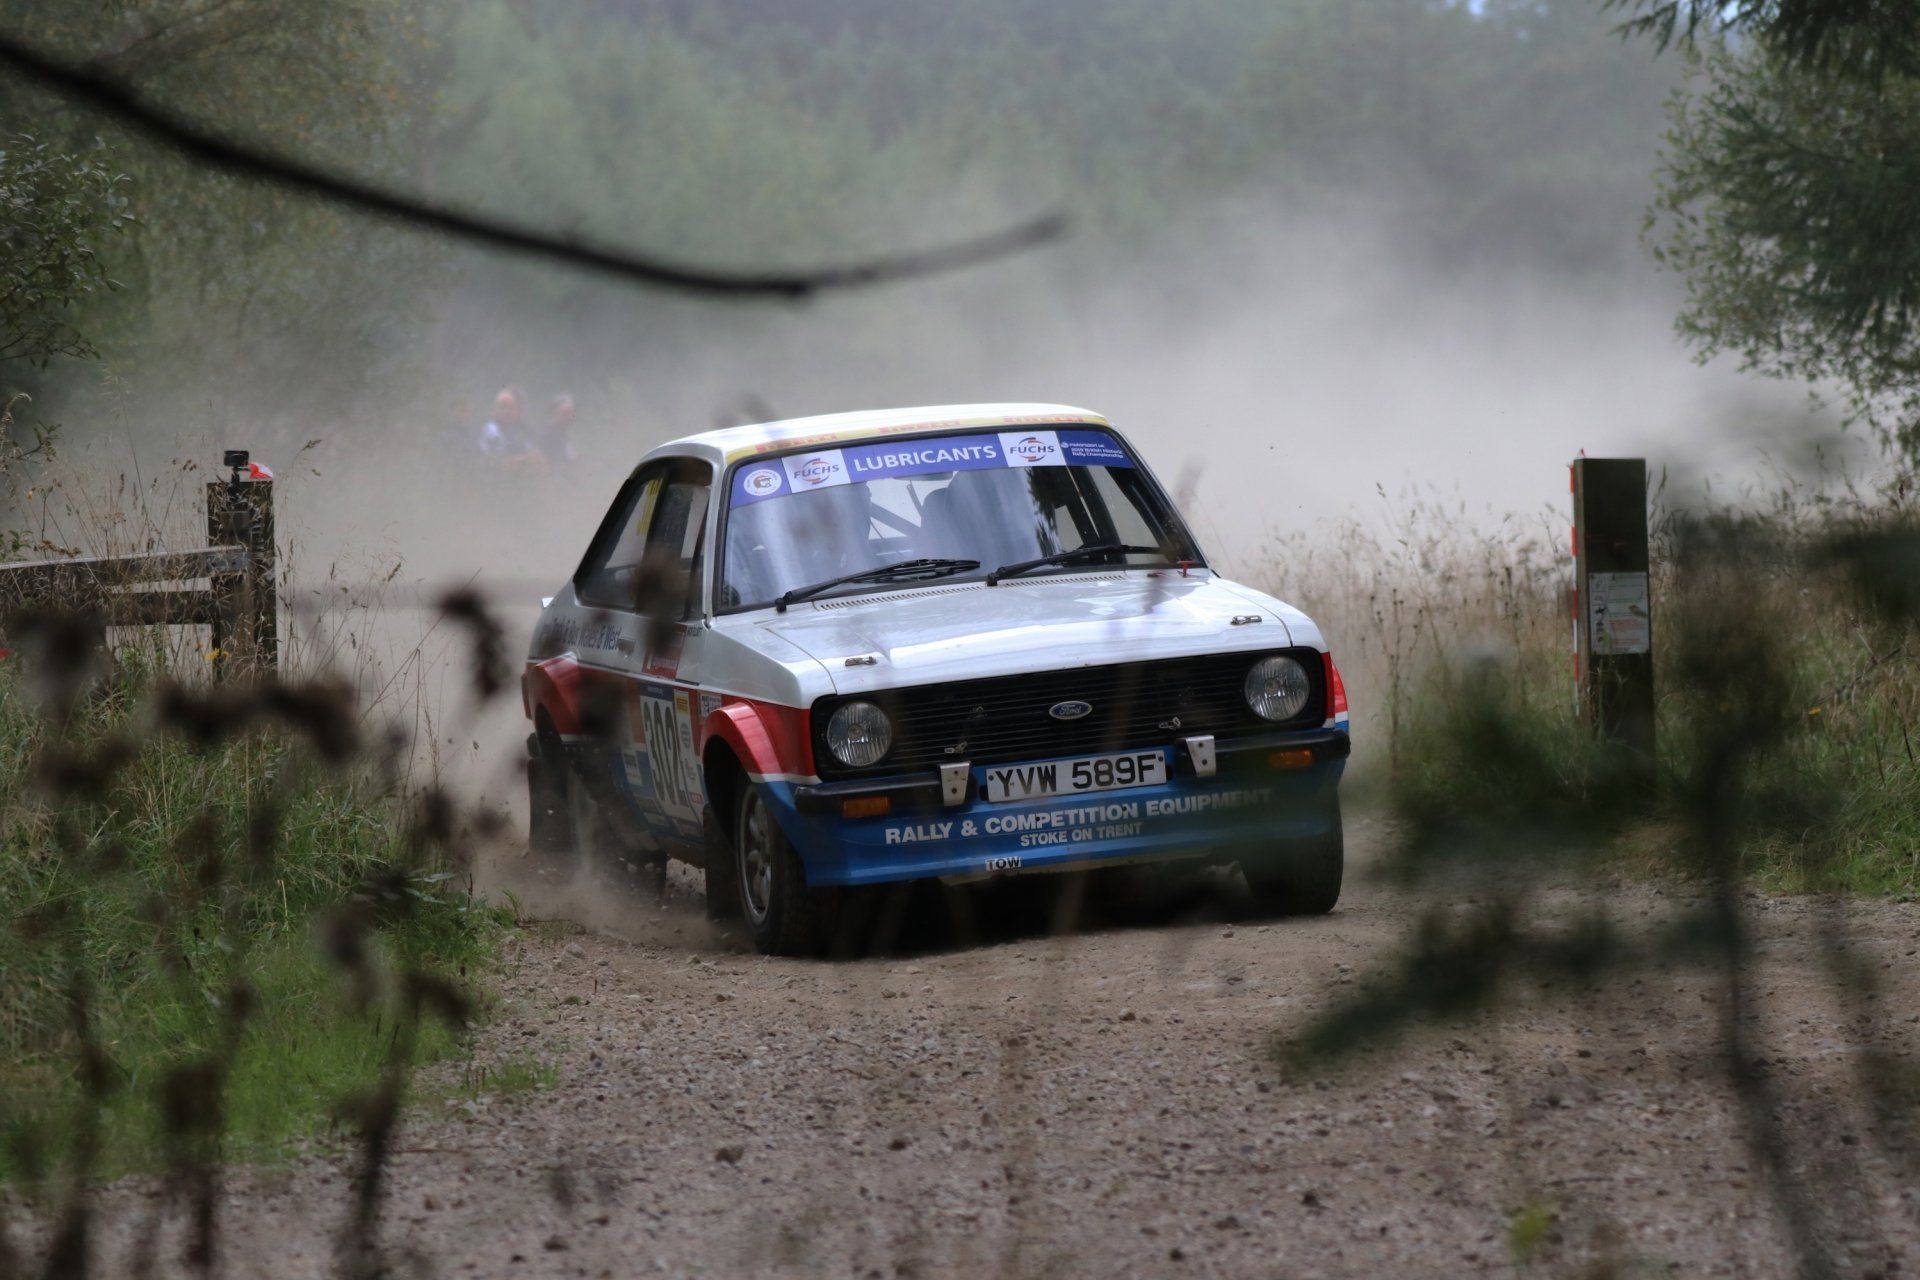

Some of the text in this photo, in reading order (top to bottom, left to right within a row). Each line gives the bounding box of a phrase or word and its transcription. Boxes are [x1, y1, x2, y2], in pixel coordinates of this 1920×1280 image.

[853, 445, 997, 472] LUBRICANTS
[1009, 445, 1055, 454] FUCHS
[793, 464, 840, 479] FUCHS
[643, 701, 692, 808] 302
[995, 754, 1157, 797] YVW 589F
[885, 788, 1273, 845] RALLY & COMPETITION EQUIPMENT
[1020, 821, 1143, 847] STOKE ON TRENT
[987, 856, 1020, 871] TOW
